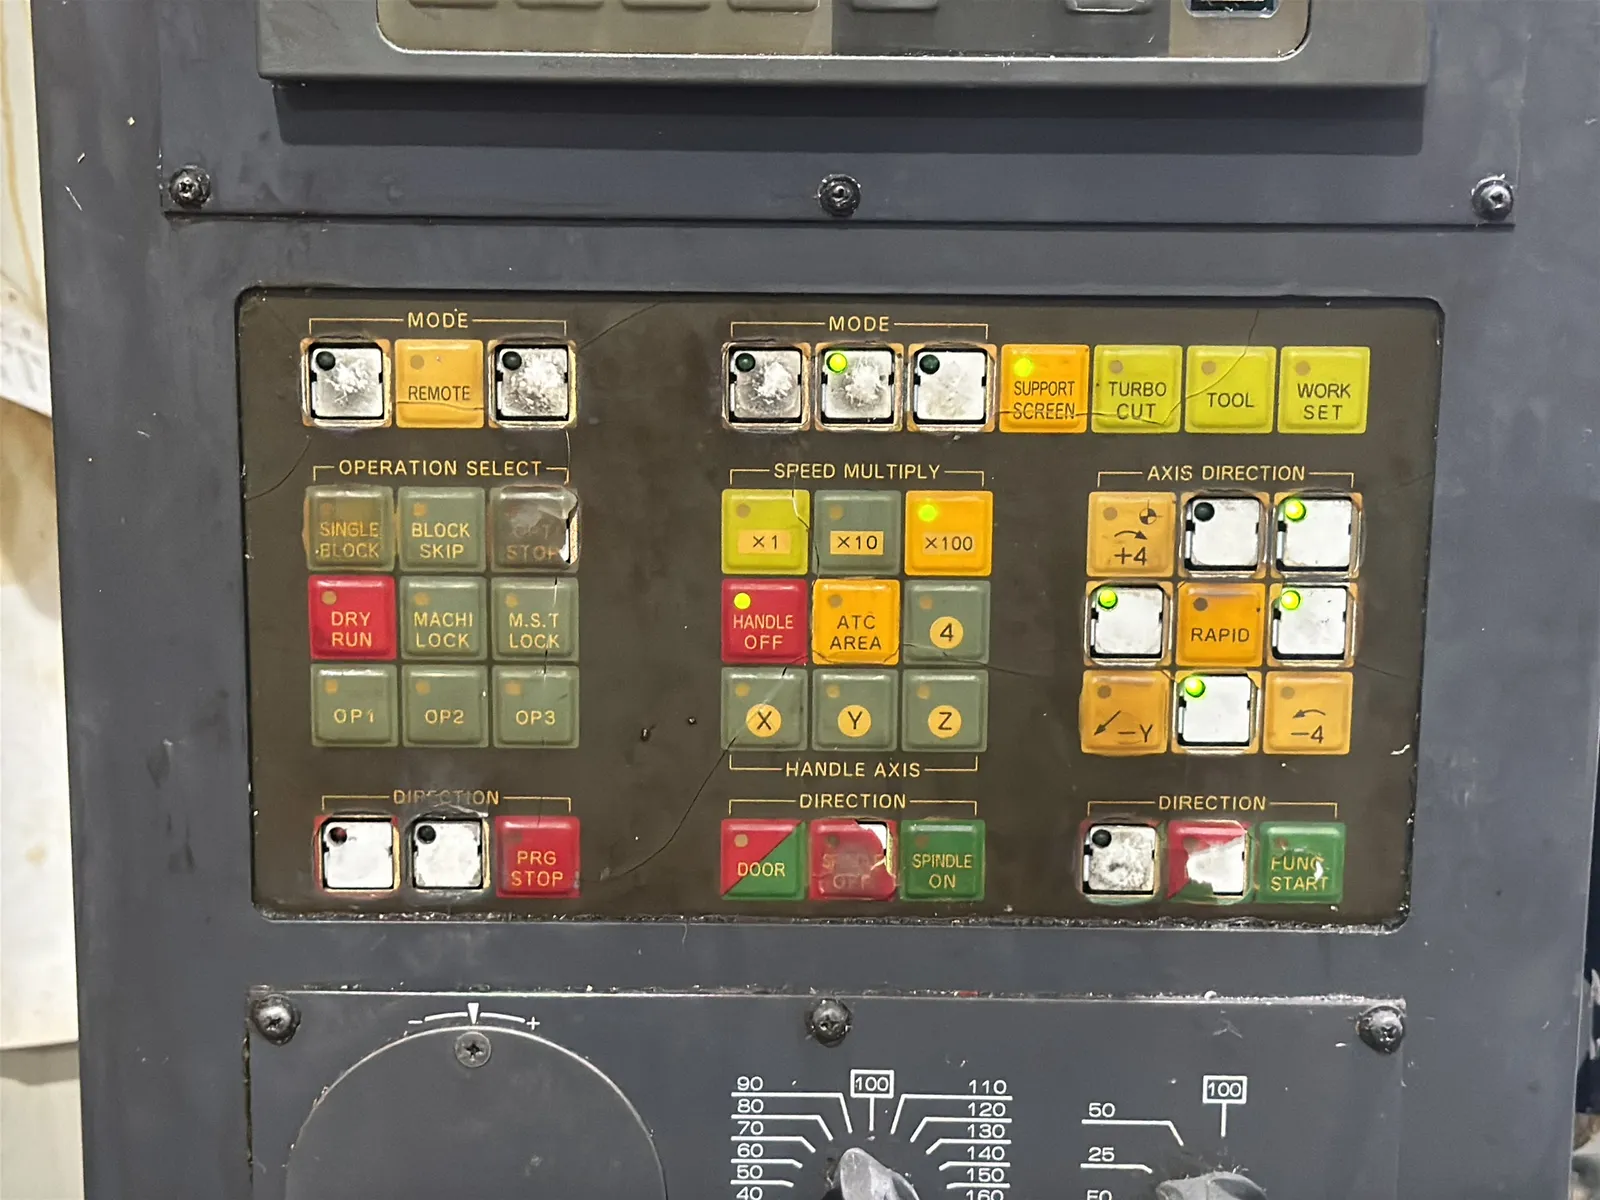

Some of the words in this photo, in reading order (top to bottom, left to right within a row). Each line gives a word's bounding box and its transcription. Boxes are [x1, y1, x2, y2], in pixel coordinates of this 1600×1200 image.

[407, 312, 469, 328] MODE
[828, 316, 890, 332] MODE
[408, 386, 471, 401] REMOTE
[1013, 381, 1075, 396] SUPPORT
[1108, 382, 1167, 397] TURBO
[1296, 383, 1352, 399] WORK
[1207, 392, 1254, 408] TOOL
[1013, 403, 1075, 420] SCREEN
[1116, 403, 1157, 420] CUT
[1303, 405, 1343, 420] SET
[338, 460, 458, 476] OPERATION
[466, 461, 542, 477] SELECT
[773, 463, 836, 479] SPEED
[843, 464, 941, 480] MULTIPLY
[1147, 465, 1193, 482] AXIS
[1202, 466, 1306, 482] DIRECTION
[319, 522, 380, 538] SINGLE
[411, 523, 470, 538] BLOCK
[319, 543, 380, 559] BLOCK
[420, 544, 464, 559] SKIP
[331, 611, 371, 627] DRY
[413, 612, 473, 627] MACHI
[509, 613, 560, 628] M.S.T
[732, 615, 794, 629] HANDLE
[837, 615, 876, 629] ATC
[331, 632, 372, 648] RUN
[415, 632, 470, 648] LOCK
[939, 623, 953, 642] 4
[1190, 627, 1250, 643] RAPID
[509, 634, 560, 649] LOCK
[744, 635, 783, 650] OFF
[829, 636, 882, 650] AREA
[333, 709, 374, 724] OP1
[424, 709, 465, 724] OP2
[515, 710, 556, 726] OP3
[756, 711, 772, 730] X
[848, 711, 863, 730] Y
[938, 712, 952, 731] Z
[785, 762, 866, 777] HANDLE
[874, 762, 921, 778] AXIS
[392, 789, 500, 805] DIRECTION
[799, 794, 907, 809] DIRECTION
[1158, 795, 1267, 811] DIRECTION
[517, 851, 557, 866] PRG
[912, 854, 973, 869] SPINDLE
[737, 862, 786, 878] DOOR
[511, 871, 564, 887] STOP
[929, 874, 957, 889] ON
[1270, 876, 1329, 891] START
[736, 1076, 764, 1091] 90
[854, 1077, 889, 1091] 100
[968, 1079, 1007, 1095] 110
[1207, 1082, 1242, 1098] 100
[736, 1098, 764, 1113] 80
[967, 1102, 1006, 1117] 120
[1088, 1102, 1116, 1118] 50
[737, 1121, 764, 1135] 70
[967, 1124, 1006, 1138] 130
[737, 1143, 764, 1158] 60
[967, 1146, 1006, 1161] 140
[1088, 1146, 1115, 1162] 25
[737, 1165, 763, 1179] 50
[967, 1168, 1005, 1182] 150
[736, 1186, 763, 1200] 40
